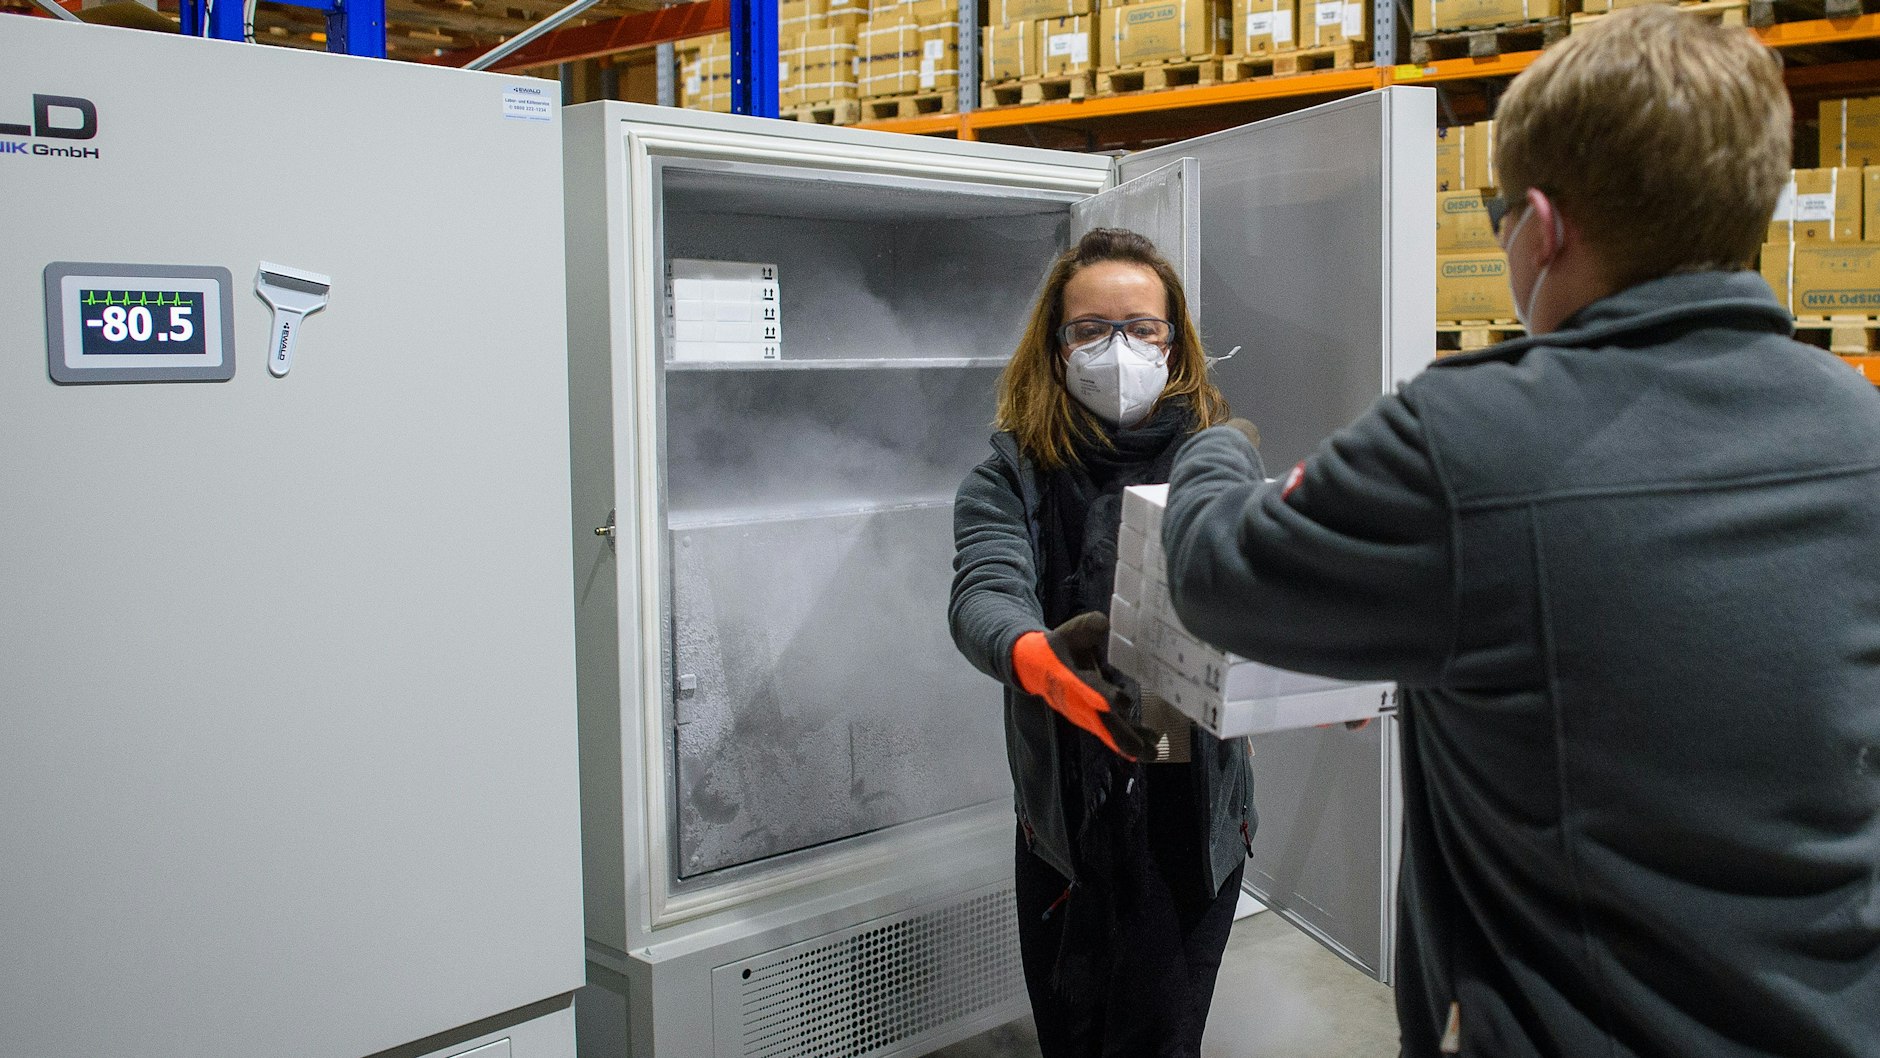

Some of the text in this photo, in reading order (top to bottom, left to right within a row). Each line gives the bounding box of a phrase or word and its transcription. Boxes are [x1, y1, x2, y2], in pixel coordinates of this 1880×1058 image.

[32, 144, 100, 159] GmbH
[1447, 200, 1479, 210] DISPO
[1446, 263, 1503, 274] DISPO VAN
[1808, 294, 1836, 304] VAN
[86, 305, 193, 342] -80.5
[280, 329, 289, 361] EWALD
